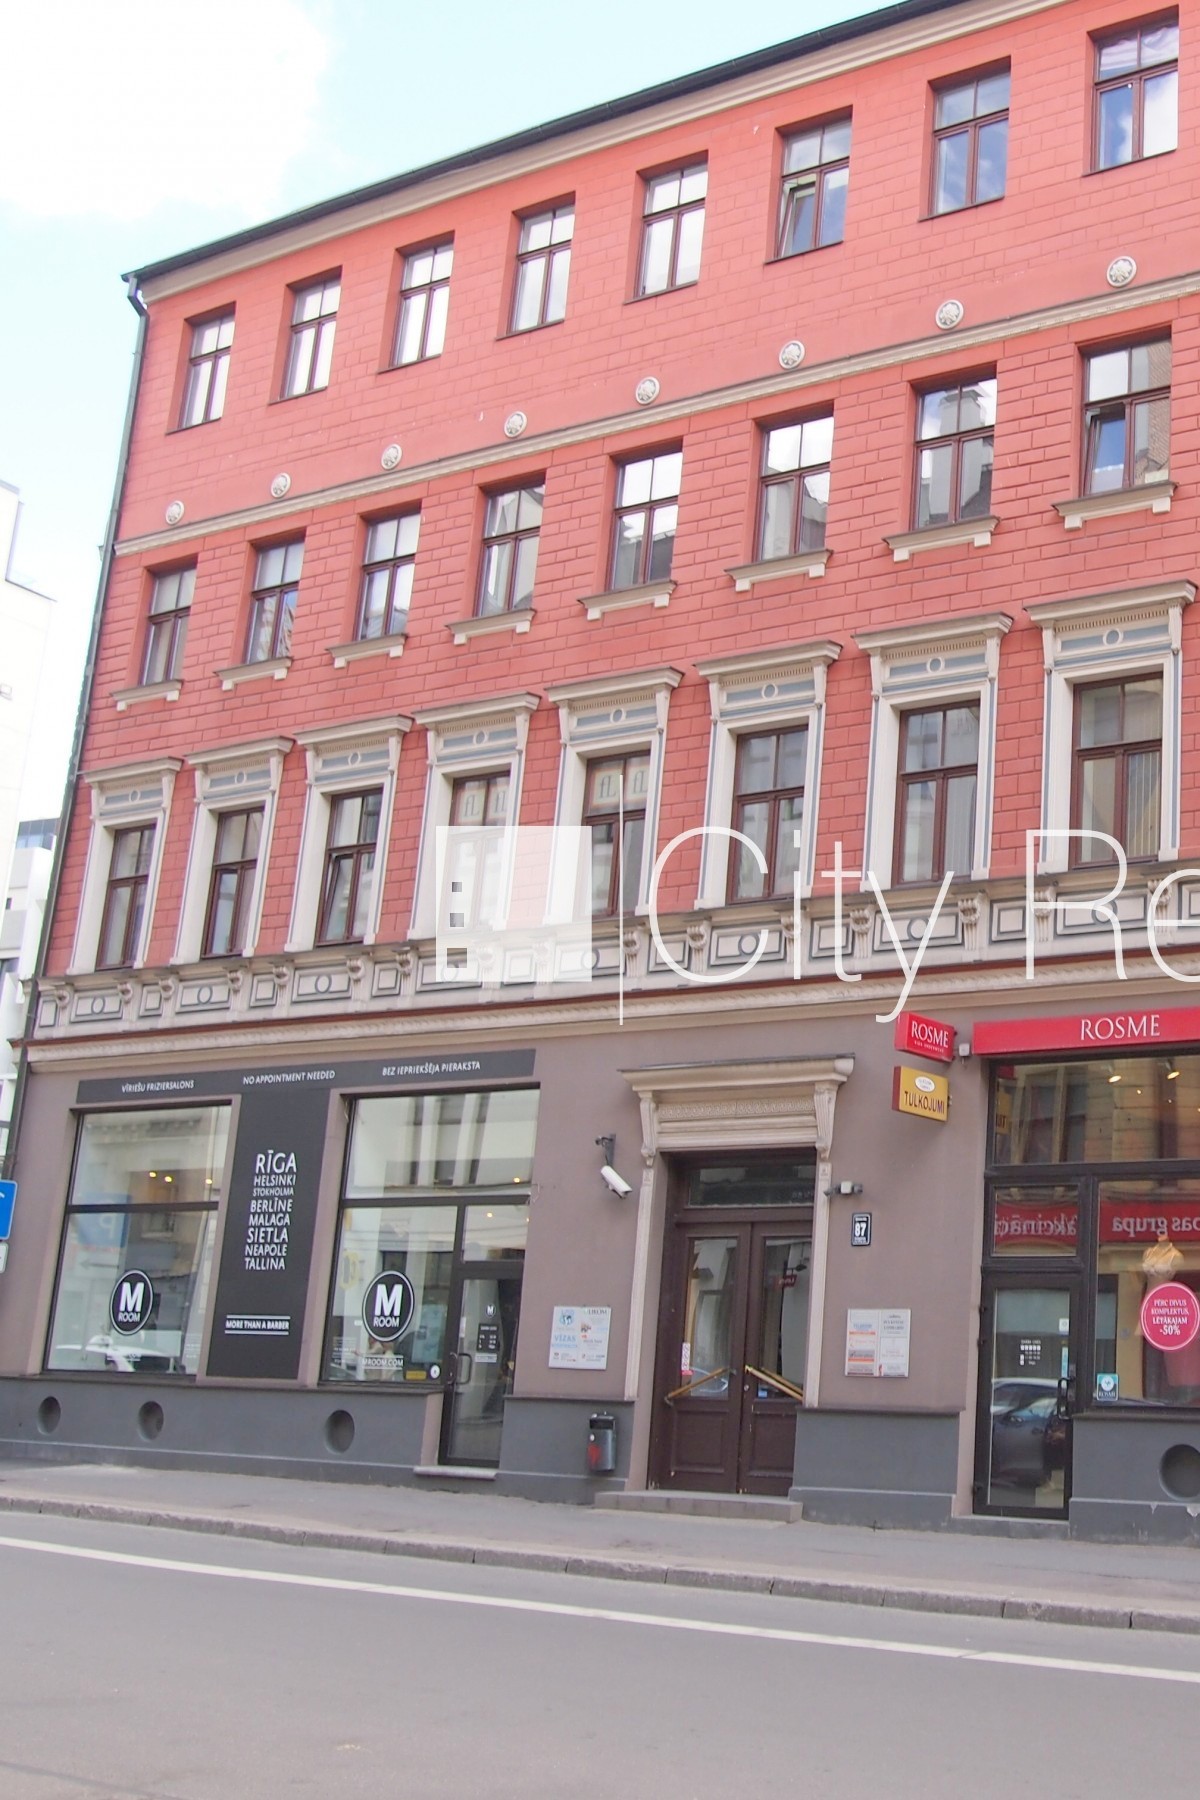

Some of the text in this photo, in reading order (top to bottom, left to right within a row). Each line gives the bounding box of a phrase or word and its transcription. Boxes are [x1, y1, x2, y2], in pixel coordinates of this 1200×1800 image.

[911, 1020, 949, 1048] ROSME
[1080, 1014, 1160, 1040] ROSME
[382, 1066, 396, 1076] BEZ
[441, 1061, 481, 1072] PIERAKSTA
[243, 1070, 335, 1085] NO APPOINTMENT NEEDED
[147, 1080, 194, 1091] FRIZIERSALONS
[904, 1091, 945, 1114] TULKOJUMI
[255, 1150, 297, 1174] RĪGA
[254, 1174, 296, 1186] HELSINKI
[252, 1187, 294, 1197] STOKHOLMA
[250, 1197, 293, 1212] BERLĪNE
[248, 1213, 290, 1226] MALAGA
[247, 1227, 288, 1243] SIETLA
[855, 1222, 867, 1237] 87
[245, 1244, 287, 1256] NEAPOLE
[245, 1257, 285, 1270] TALLINA
[119, 1282, 145, 1312] M
[374, 1284, 403, 1316] M
[118, 1312, 141, 1322] ROOM
[373, 1316, 400, 1328] ROOM
[225, 1320, 290, 1330] MORE THAN A BARBER
[1160, 1325, 1181, 1335] -50%
